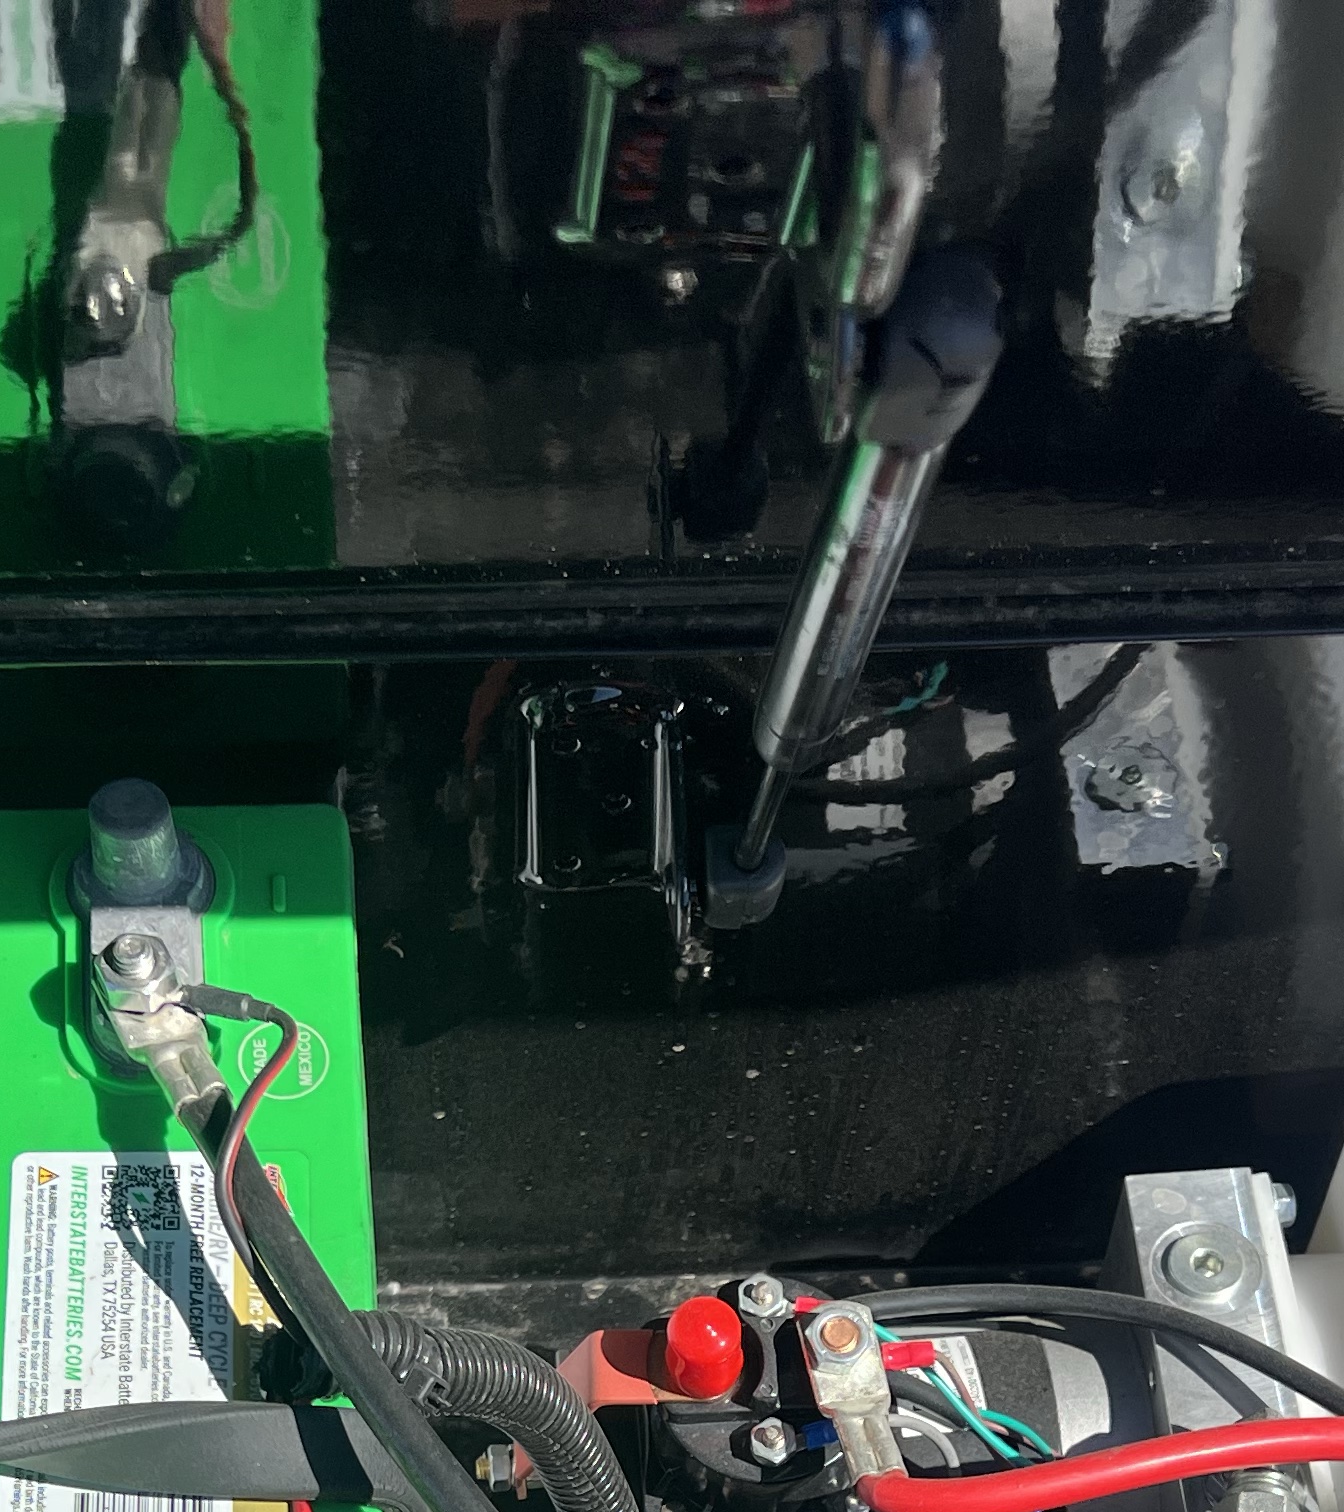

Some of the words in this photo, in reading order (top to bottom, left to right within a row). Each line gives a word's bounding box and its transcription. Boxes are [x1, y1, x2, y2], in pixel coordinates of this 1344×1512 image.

[297, 1031, 313, 1086] MEXICO
[189, 1163, 205, 1230] 12-MONTH
[101, 1241, 118, 1278] Dallas,
[120, 1241, 136, 1300] Distributed
[189, 1233, 205, 1263] FREE
[64, 1165, 88, 1382] INTERSTATEBATTERIES.COM
[103, 1280, 117, 1295] TX
[102, 1297, 117, 1333] 75254
[115, 1302, 135, 1316] by
[188, 1266, 204, 1362] REPLACEMENT
[207, 1282, 230, 1326] DEEP
[100, 1335, 115, 1360] USA
[118, 1318, 134, 1372] Interstate
[150, 1325, 161, 1402] interstatebatteries.co
[207, 1330, 228, 1389] CYCLE
[117, 1375, 133, 1406] Batte
